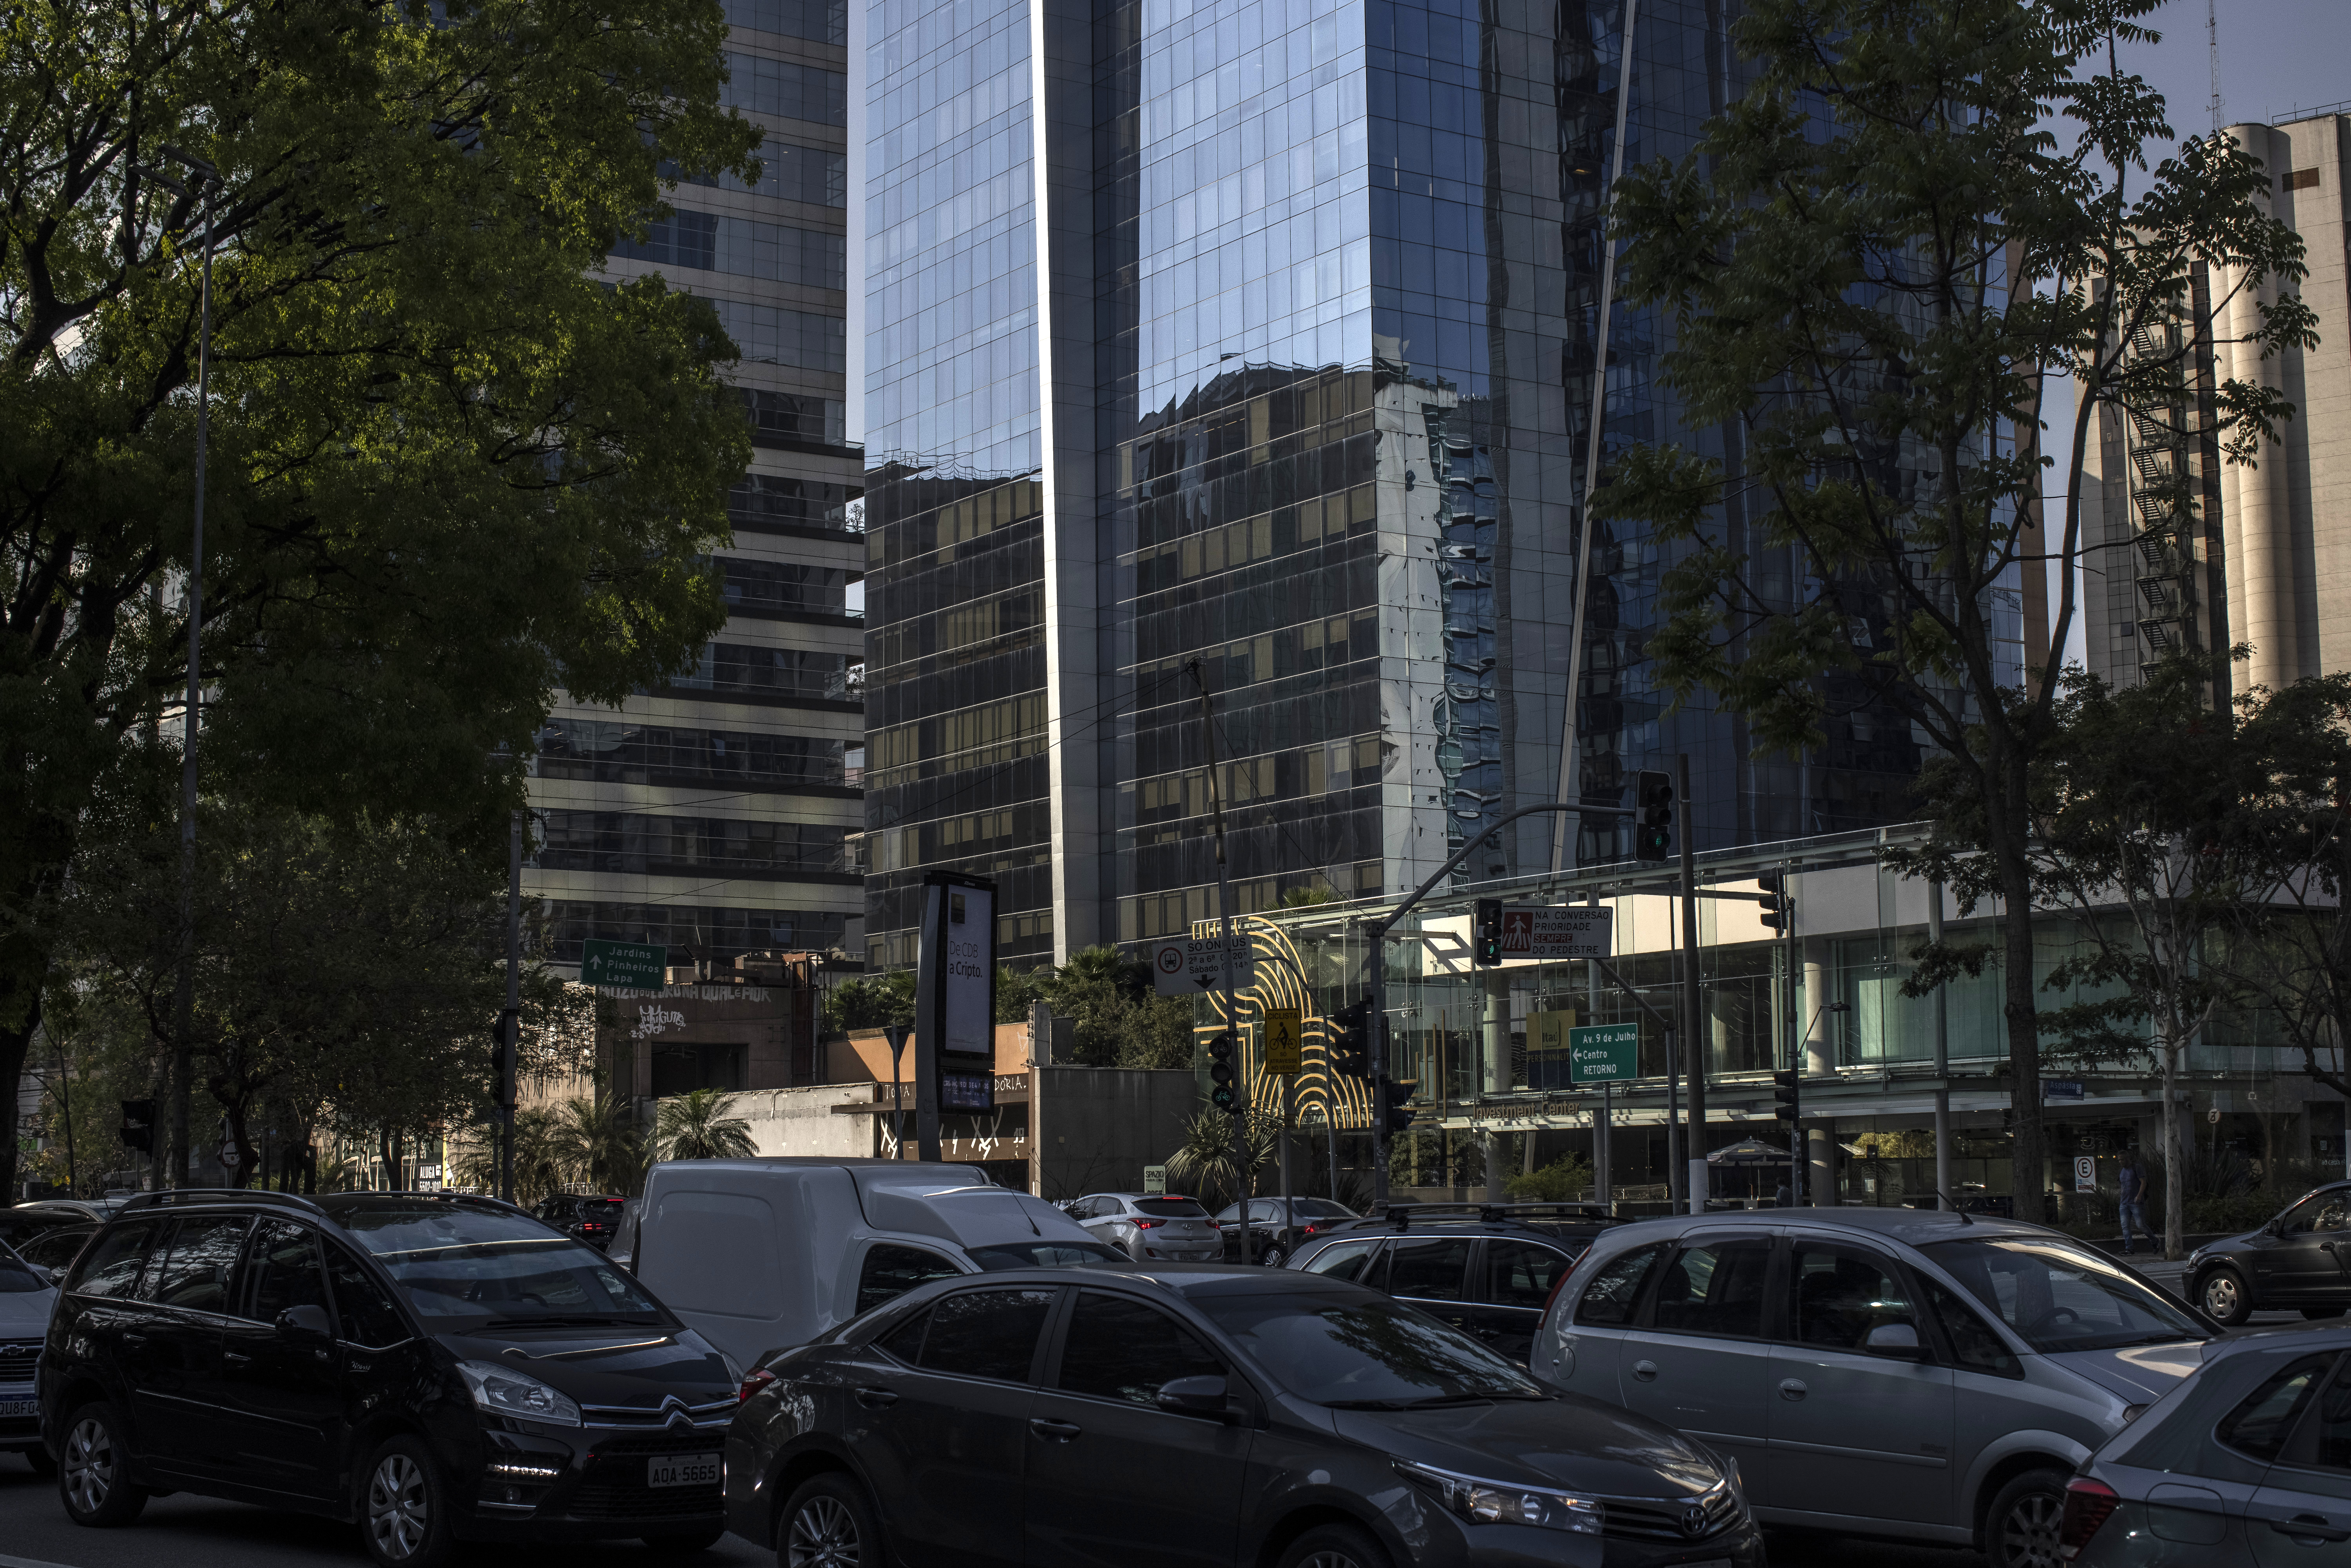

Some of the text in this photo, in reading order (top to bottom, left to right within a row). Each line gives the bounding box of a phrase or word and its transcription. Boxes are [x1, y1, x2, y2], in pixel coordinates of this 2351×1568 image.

[1535, 910, 1608, 920] NA CONVERSÃO
[1534, 923, 1591, 931] PRIORIDADE
[1534, 934, 1572, 943] SEMPRE
[950, 941, 978, 958] De CDB
[1188, 938, 1246, 952] SÓ ÔNUS
[1533, 945, 1599, 954] DO PEDESTRE
[609, 947, 651, 959] Jardins
[607, 960, 659, 973] Pinheiros
[949, 961, 982, 980] a Cripto.
[1189, 964, 1219, 974] Sábado
[607, 972, 632, 983] Lapa
[702, 985, 735, 1003] QUAL
[742, 987, 772, 1003] PIOR
[1542, 1032, 1558, 1043] Itaú
[1583, 1032, 1636, 1044] Av. 9 de Julho
[1528, 1052, 1569, 1063] PERSONNALIT
[1583, 1050, 1607, 1059] Centro
[1584, 1064, 1617, 1075] RETORNO
[2050, 1081, 2076, 1090] Aspásia
[885, 1085, 909, 1099] TOA
[1473, 1101, 1580, 1119] Investment Center
[419, 1166, 435, 1179] ALUGA
[2081, 1162, 2088, 1174] E
